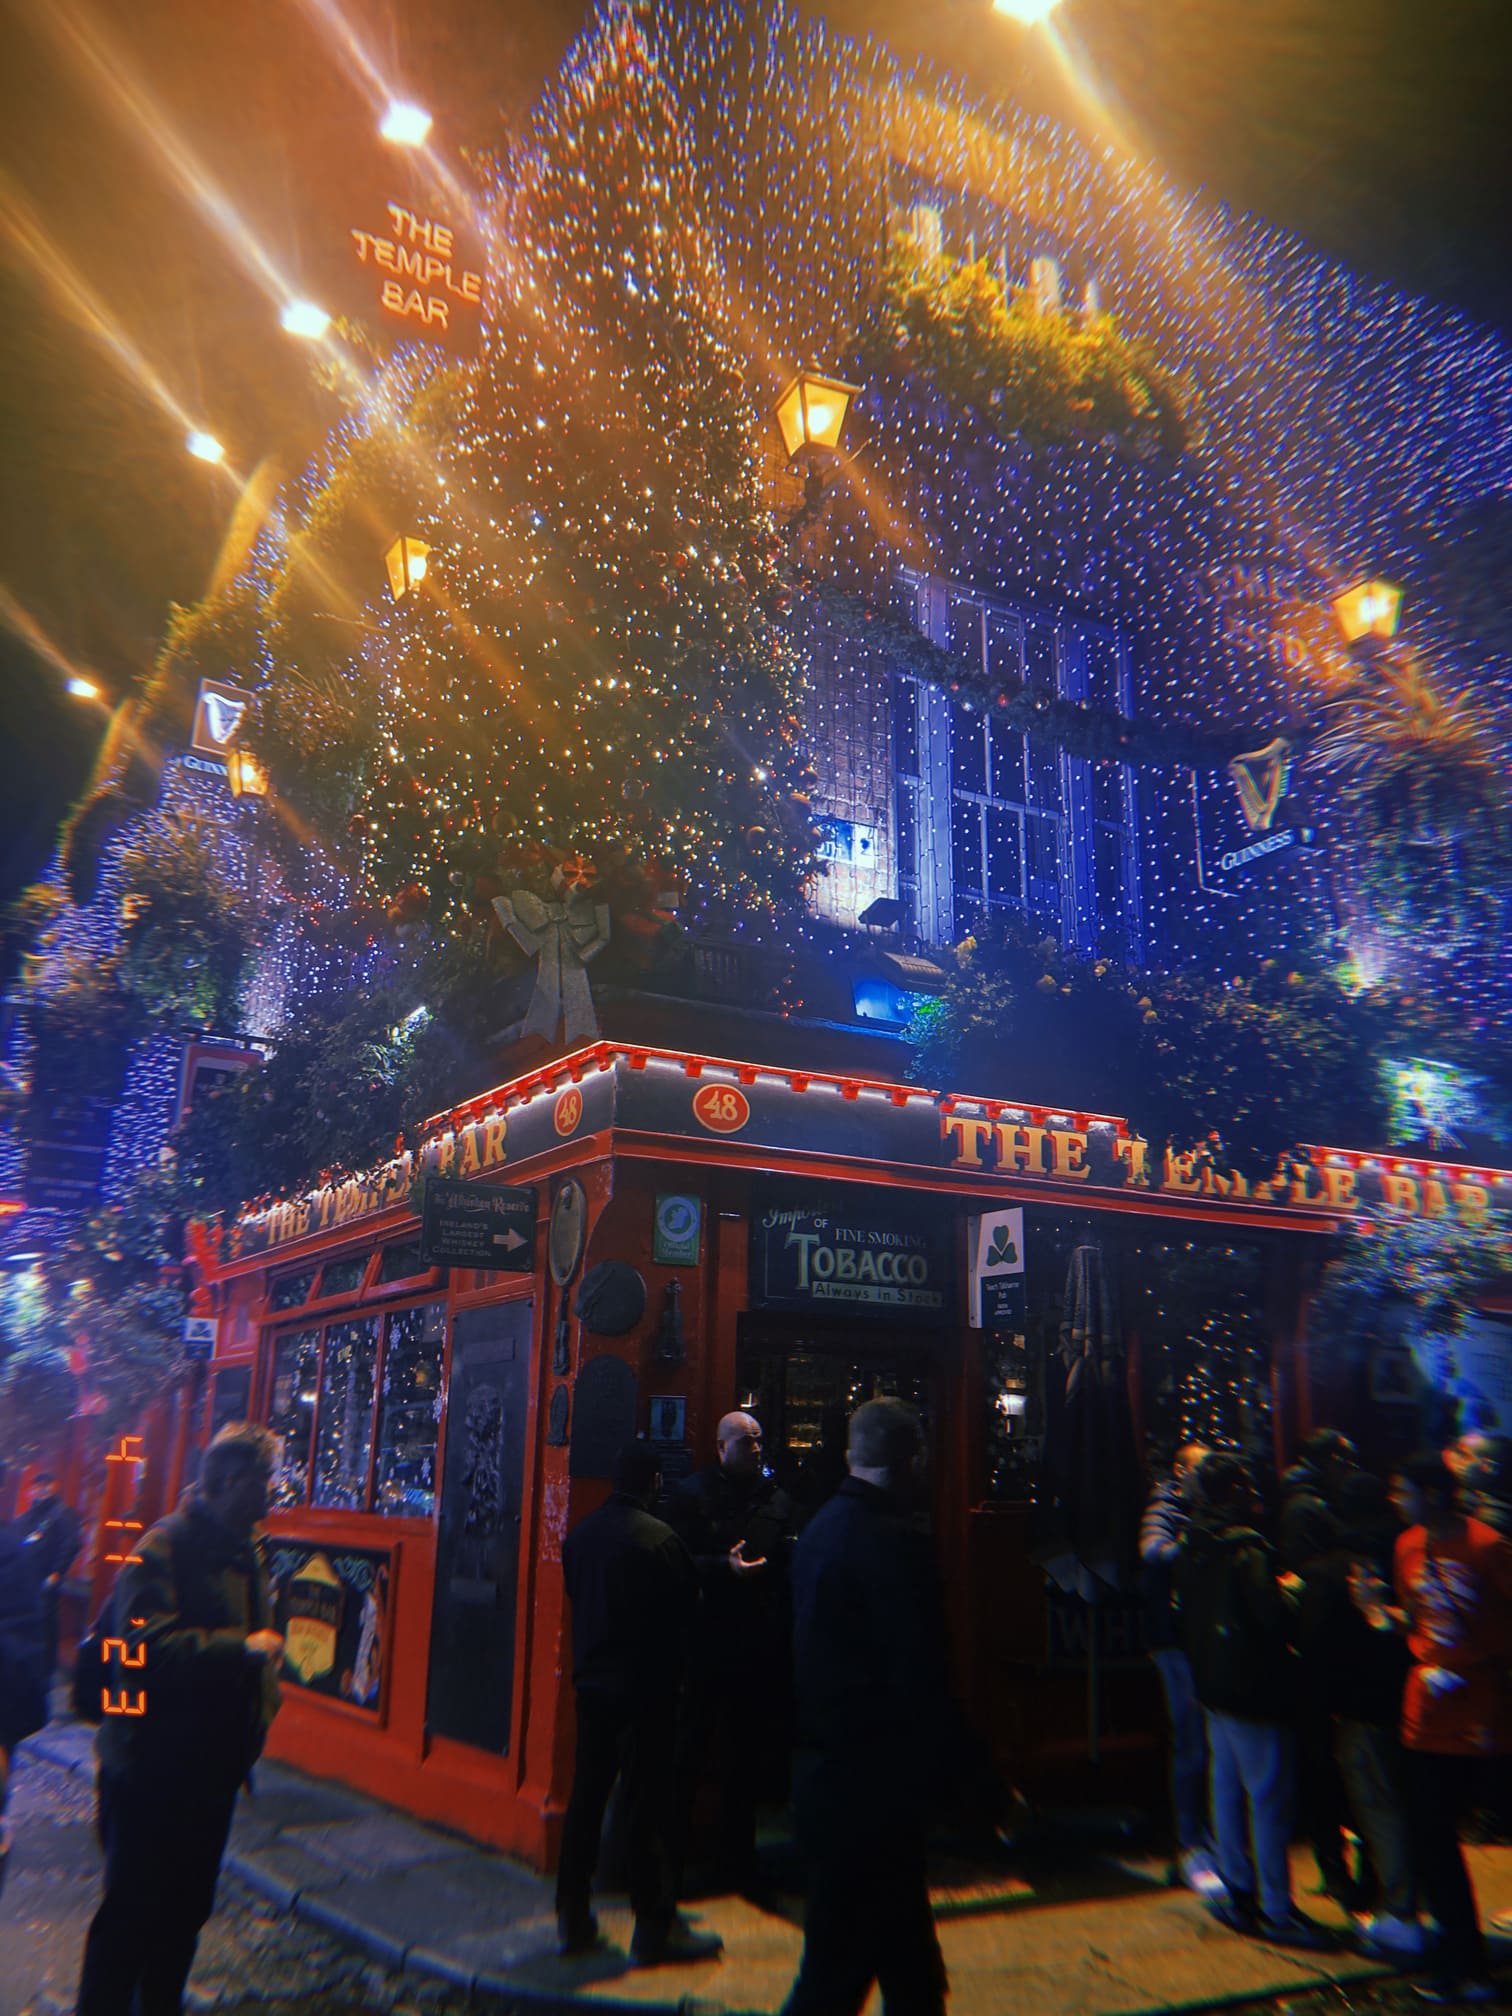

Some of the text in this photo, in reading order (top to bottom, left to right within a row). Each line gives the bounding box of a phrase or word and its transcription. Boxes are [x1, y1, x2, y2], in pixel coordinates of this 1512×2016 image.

[387, 200, 454, 258] THE
[350, 228, 482, 302] TEMPLE
[381, 279, 449, 329] BAR
[1221, 828, 1296, 871] GUINNESS
[559, 1094, 578, 1128] 48
[703, 1089, 739, 1121] 48
[265, 1200, 313, 1247] THE
[438, 1118, 508, 1179] BAR
[943, 1115, 1092, 1181] THE
[1383, 1175, 1492, 1223] BAR
[813, 1217, 830, 1229] OF
[834, 1227, 865, 1244] FINE
[814, 1282, 870, 1301] Always
